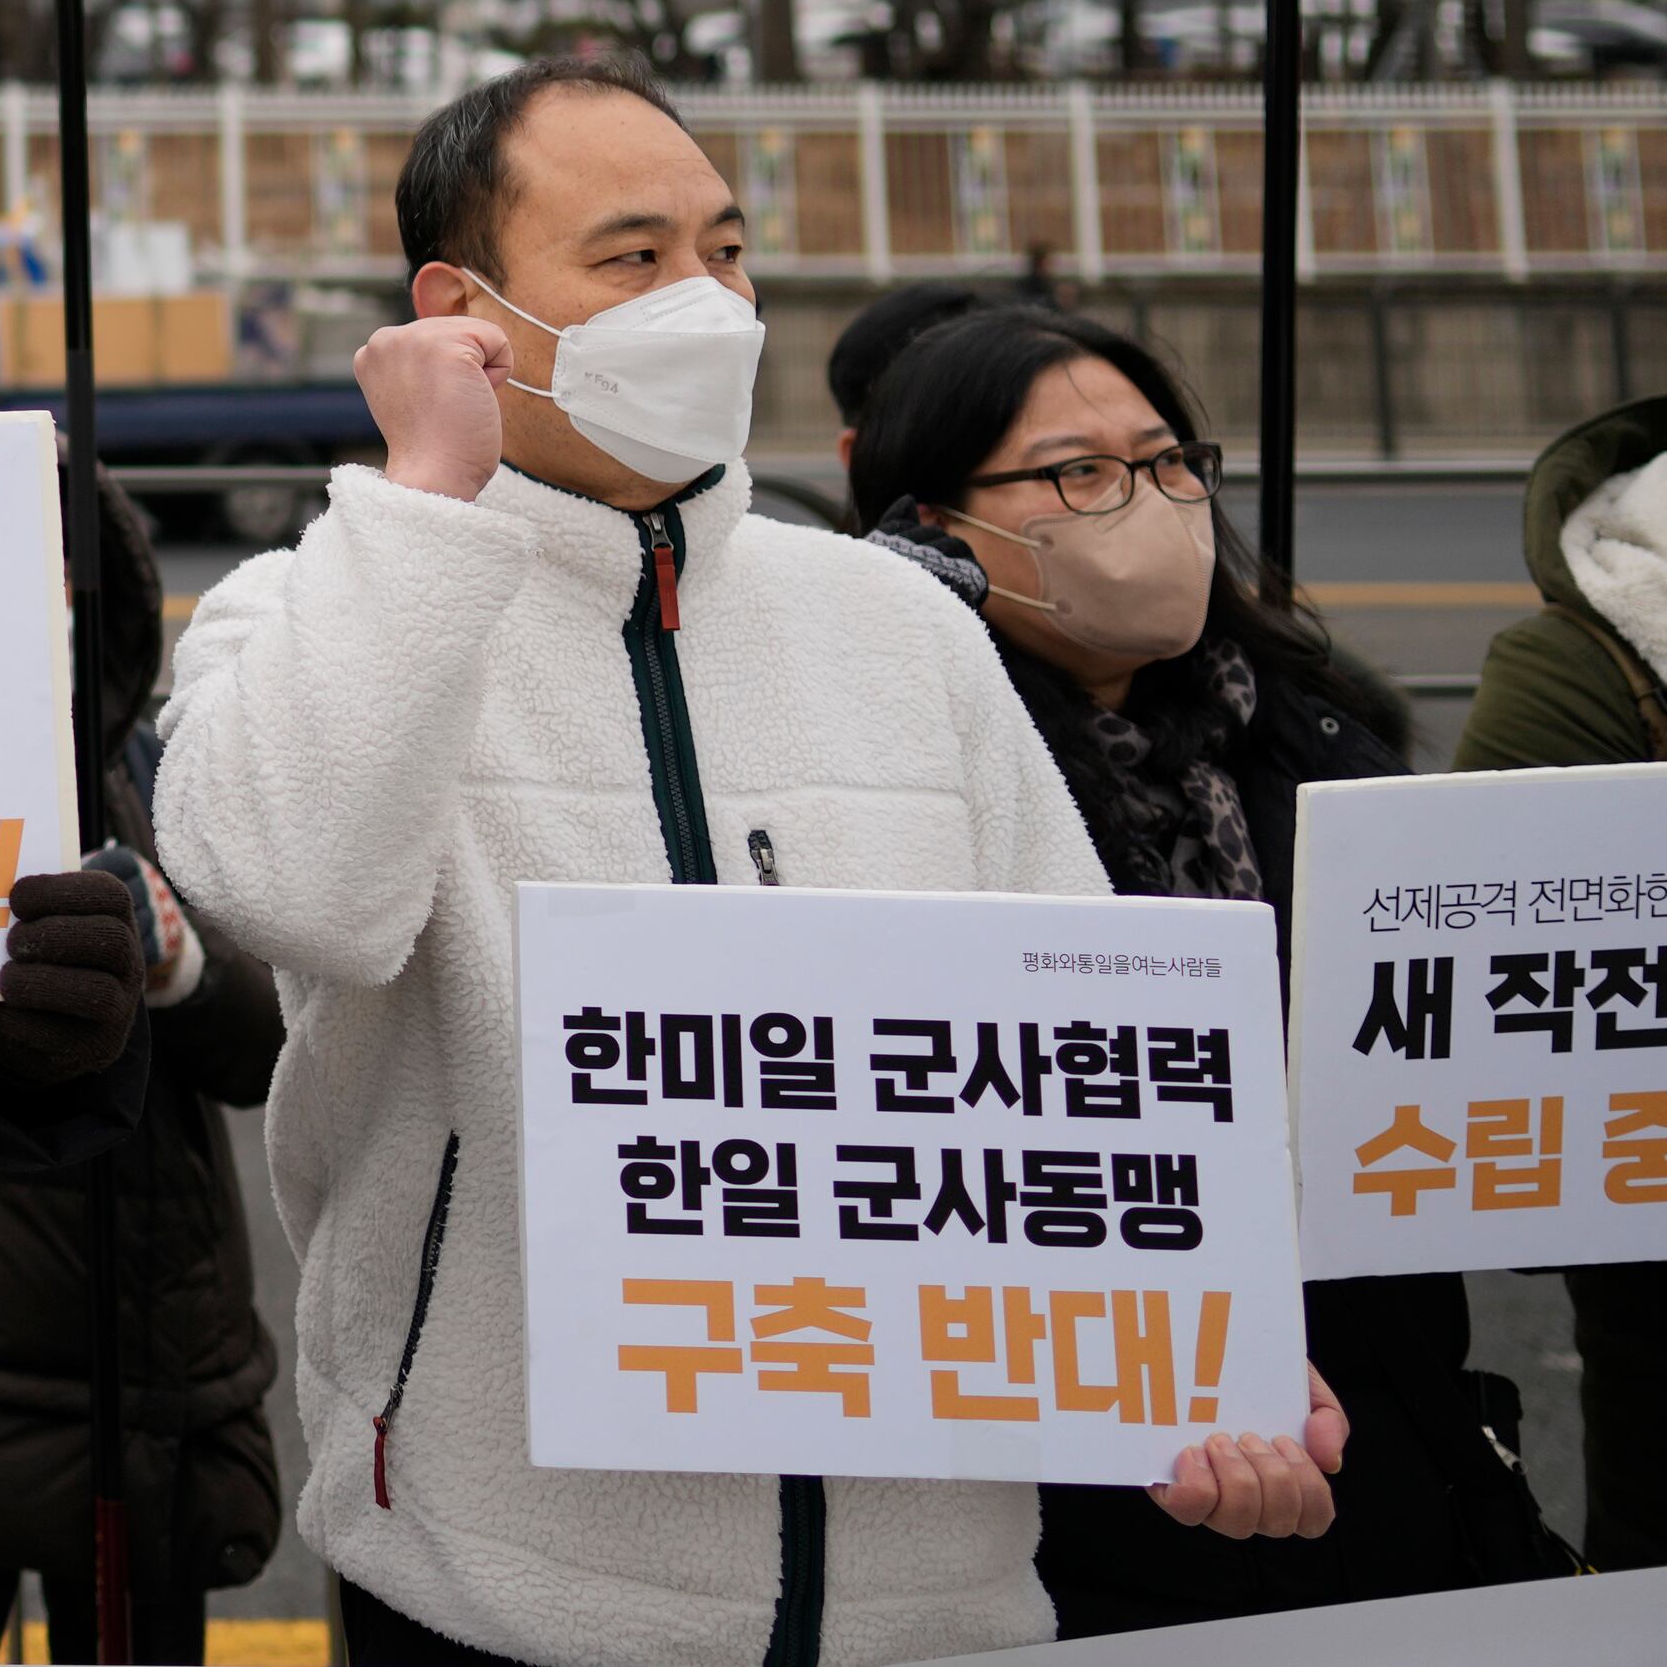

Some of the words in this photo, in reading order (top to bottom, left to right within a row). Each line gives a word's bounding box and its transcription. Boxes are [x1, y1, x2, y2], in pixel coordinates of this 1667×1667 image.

[1363, 880, 1516, 932] 선제공격
[1023, 953, 1222, 977] 평화와통일을여는사람들
[1352, 957, 1454, 1060] 새
[563, 1007, 837, 1110] 한미일
[870, 1019, 1233, 1122] 군사협력
[618, 1136, 800, 1238] 한일
[833, 1145, 1203, 1251] 군사동맹
[1353, 1096, 1564, 1216] 수립
[618, 1277, 875, 1418] 구축
[918, 1285, 1231, 1426] 반대!
